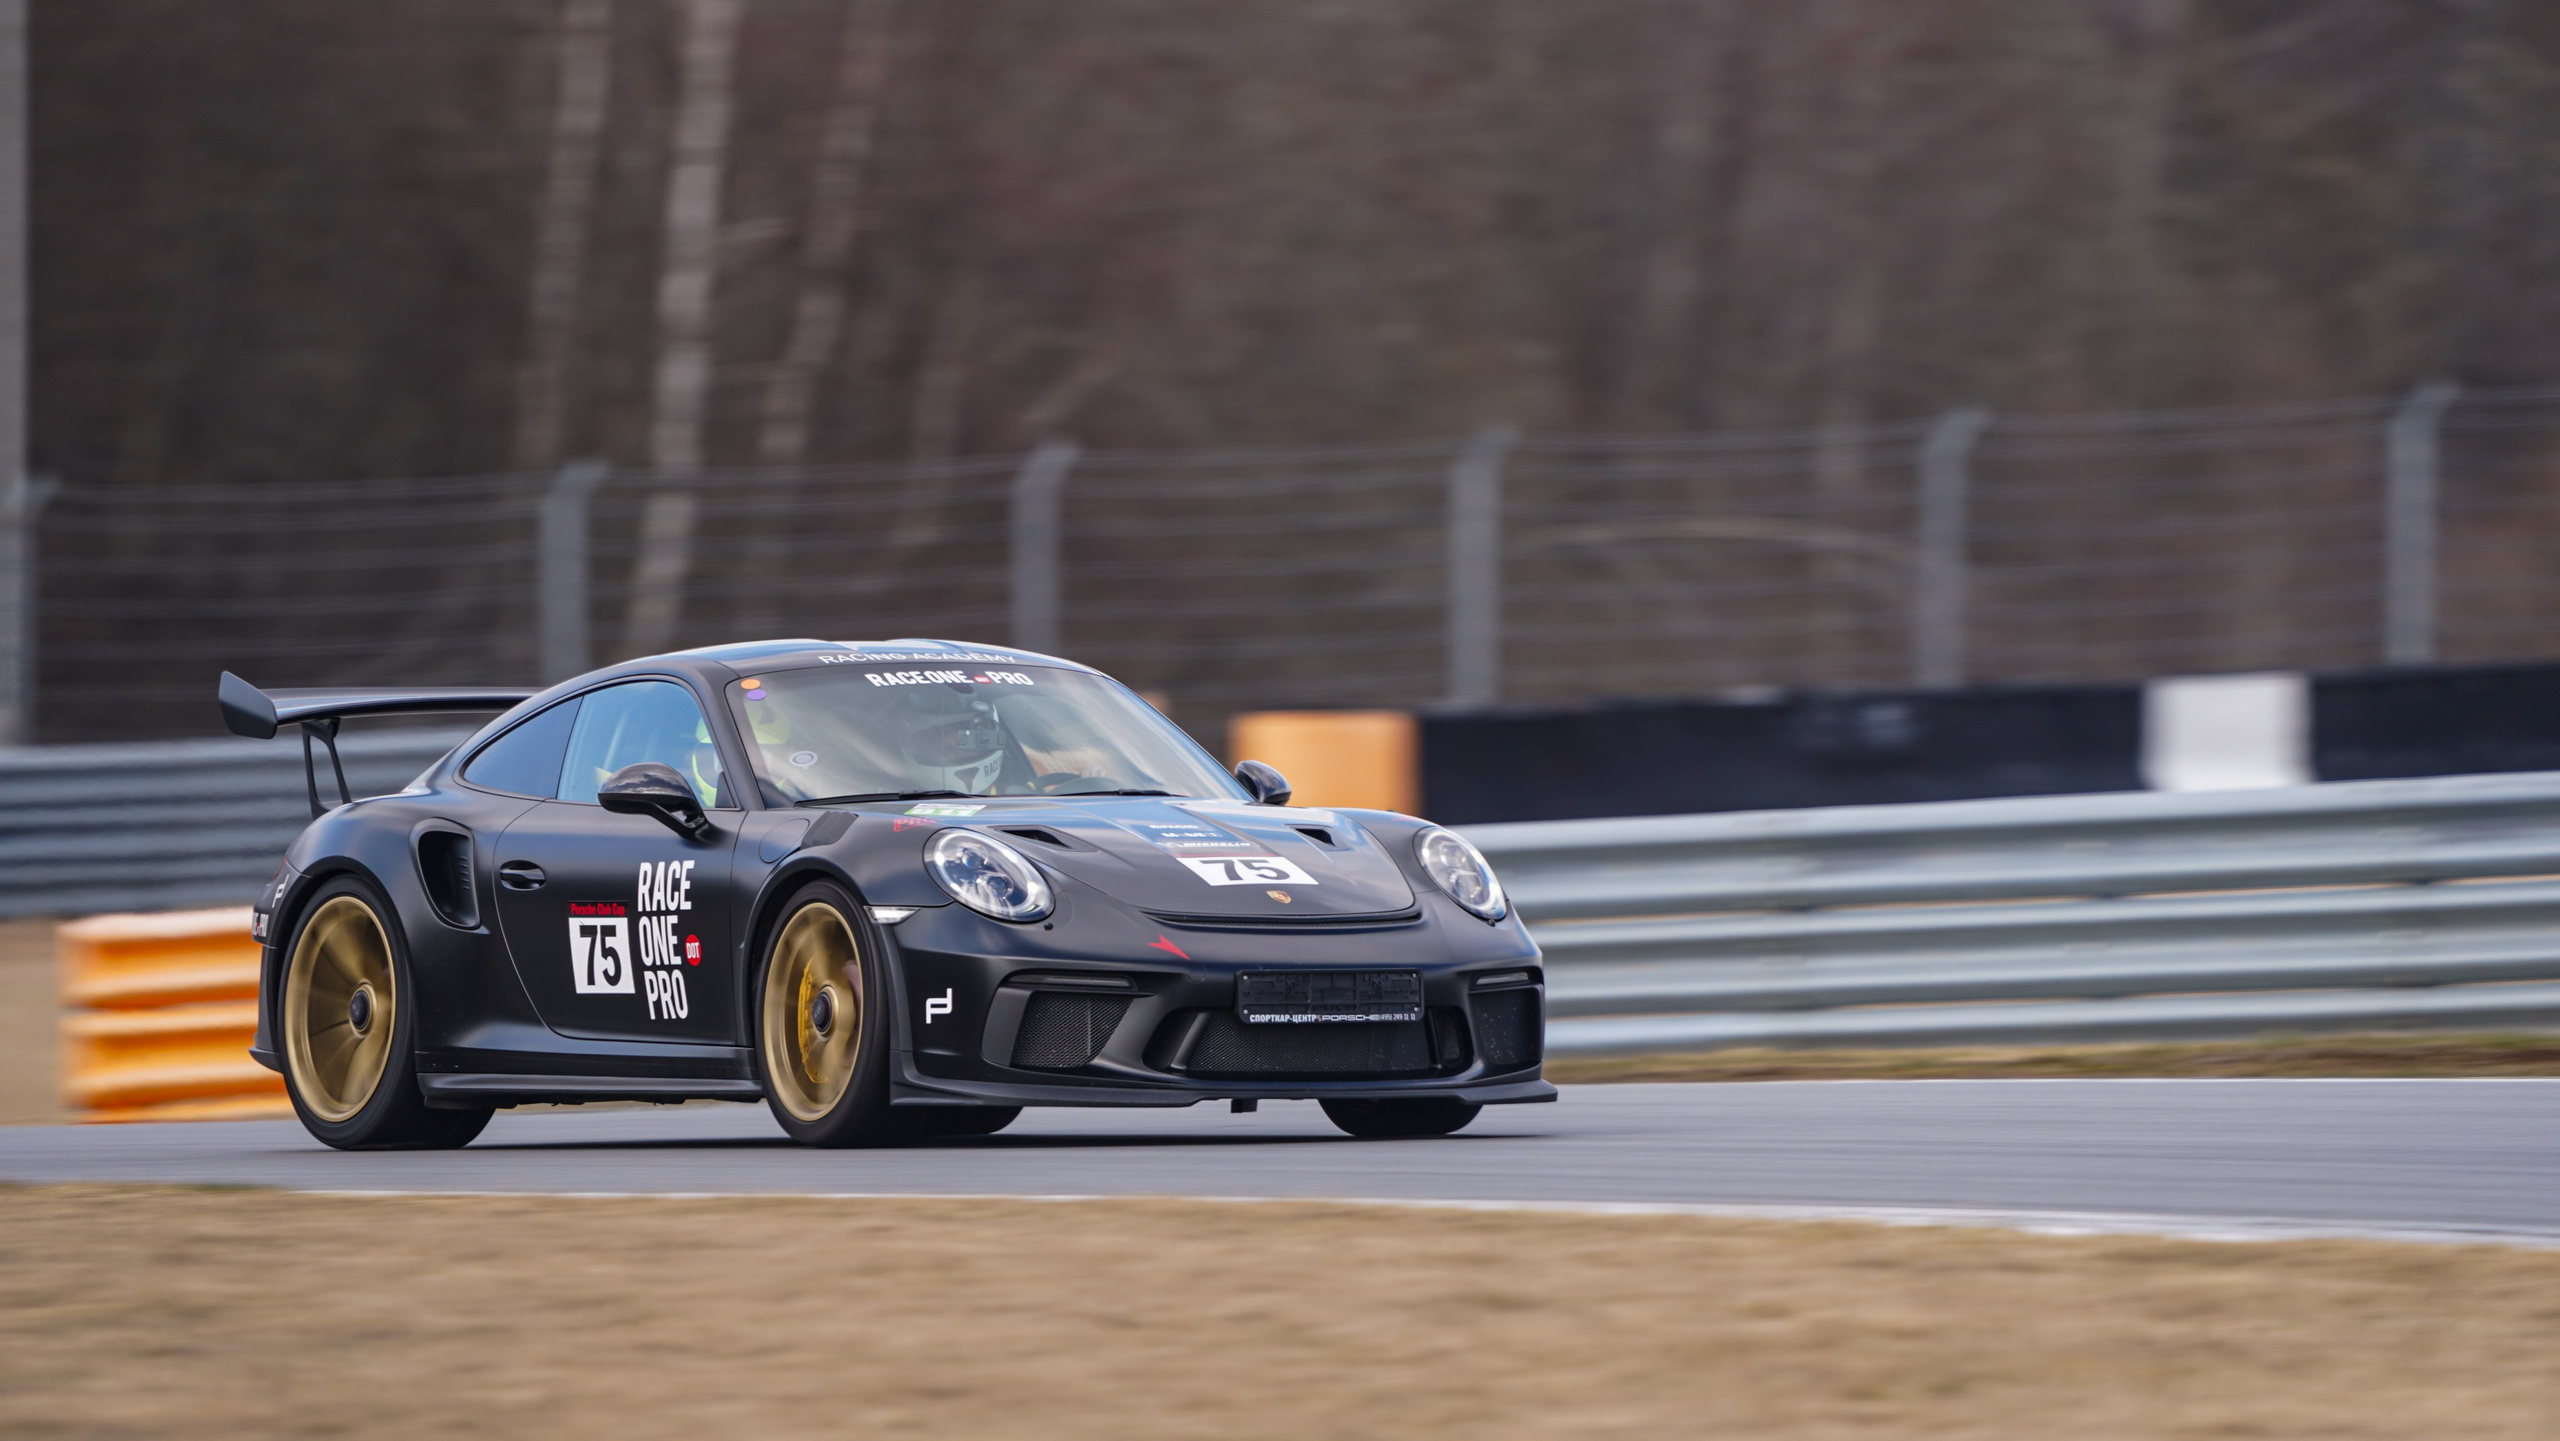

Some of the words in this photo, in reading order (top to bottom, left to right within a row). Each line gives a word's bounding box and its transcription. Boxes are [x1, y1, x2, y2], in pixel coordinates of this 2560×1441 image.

[818, 652, 907, 665] RACING
[912, 652, 1017, 664] ACADEMY
[984, 671, 1035, 686] PRO
[1198, 859, 1291, 881] 75
[637, 859, 695, 912] RACE
[570, 902, 596, 915] Porsche
[596, 902, 612, 915] Club
[612, 902, 626, 917] Cup
[637, 914, 682, 967] ONE
[578, 924, 622, 987] 75
[685, 941, 700, 959] DOT
[643, 969, 689, 1021] PRO
[1249, 1013, 1317, 1023] СПОРТКАР-ЦЕНТР
[1393, 1013, 1403, 1021] 249
